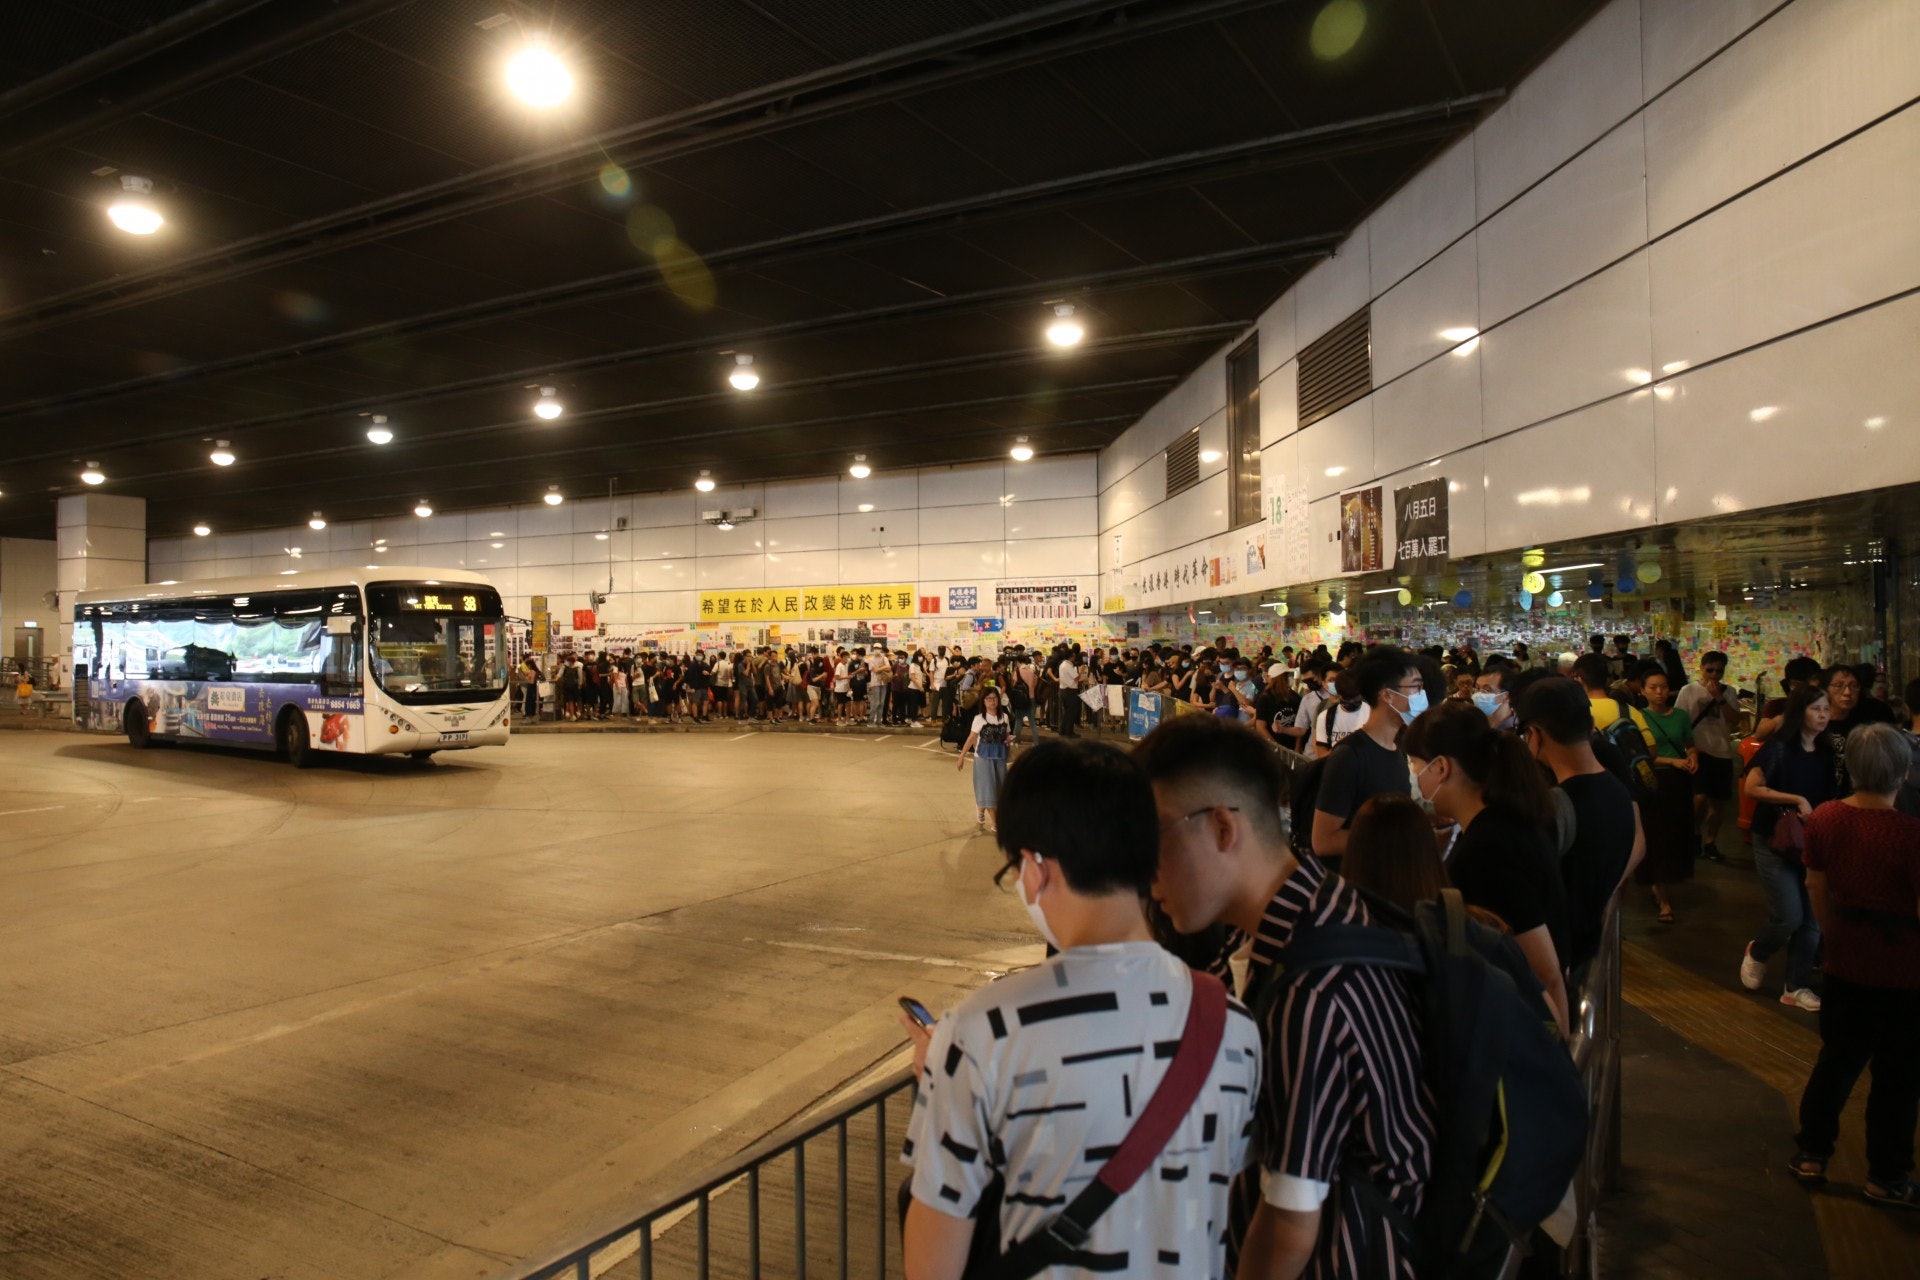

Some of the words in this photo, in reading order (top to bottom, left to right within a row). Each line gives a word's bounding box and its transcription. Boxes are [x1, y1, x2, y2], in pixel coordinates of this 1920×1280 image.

[1269, 495, 1283, 526] 18
[1404, 496, 1436, 522] 八月五日
[1398, 536, 1448, 561] 七百萬人罷工
[1174, 556, 1208, 588] 時代革命
[463, 595, 477, 612] 38
[701, 597, 798, 614] 希望在於人民
[804, 592, 912, 611] 改變始於抗爭
